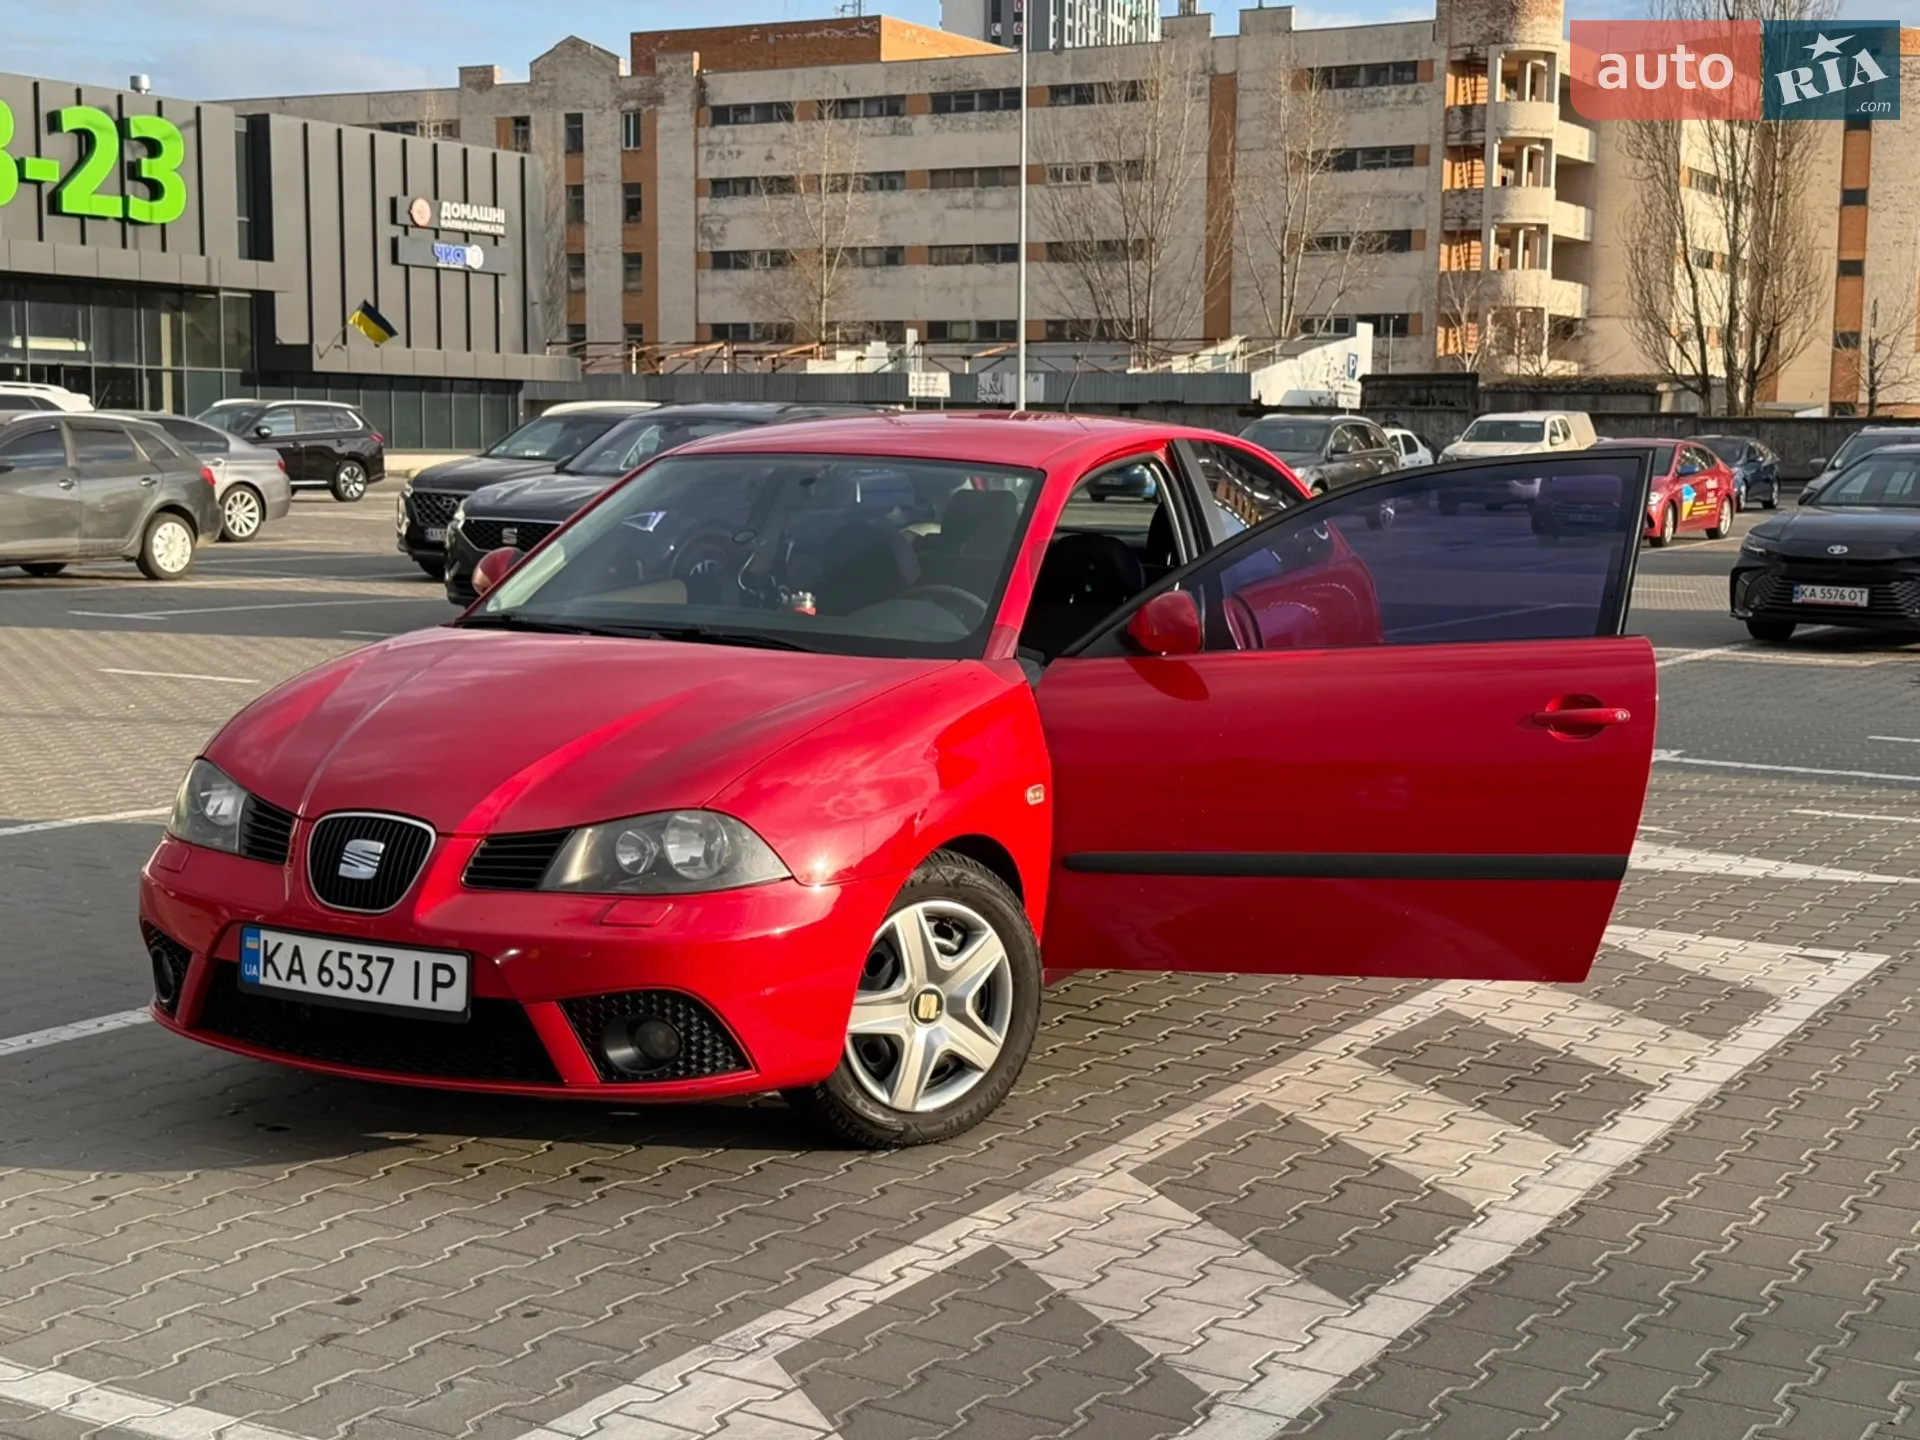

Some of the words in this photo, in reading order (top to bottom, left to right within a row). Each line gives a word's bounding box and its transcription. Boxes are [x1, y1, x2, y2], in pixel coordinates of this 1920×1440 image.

[440, 201, 505, 223] ДОМАШНІ
[1800, 587, 1817, 598] KA
[1820, 588, 1846, 600] 5576
[1848, 589, 1866, 601] OT
[244, 962, 259, 977] UA
[263, 939, 307, 985] KA
[317, 949, 395, 995] 6537
[413, 960, 457, 1002] IP
